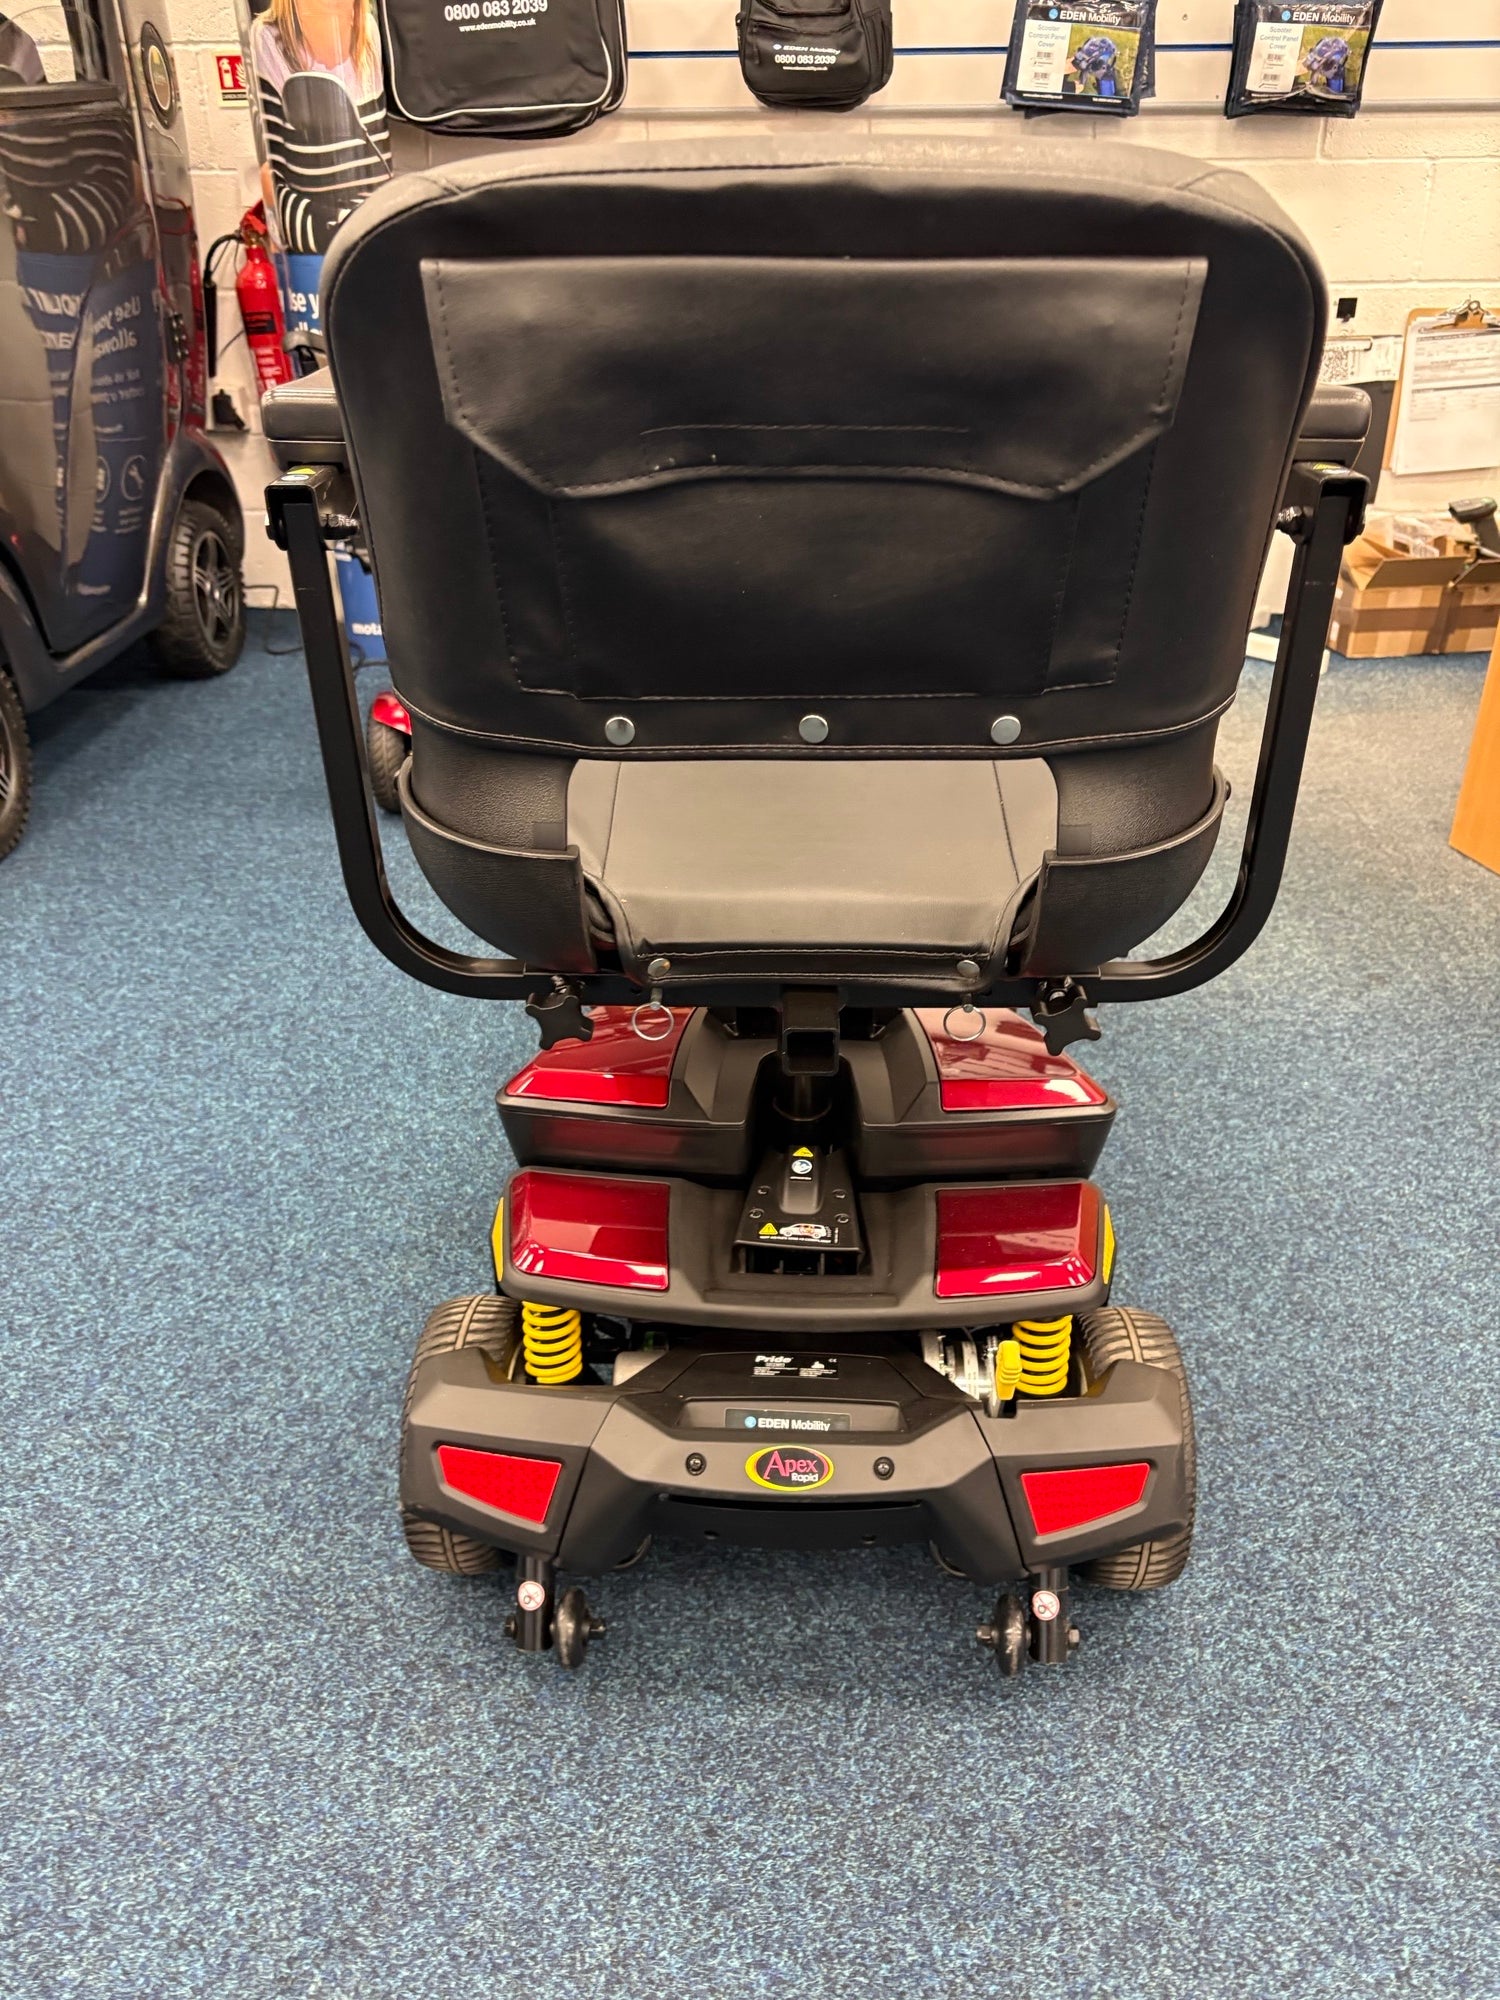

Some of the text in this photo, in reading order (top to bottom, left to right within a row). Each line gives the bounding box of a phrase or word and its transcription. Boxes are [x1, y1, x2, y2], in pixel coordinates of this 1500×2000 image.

[444, 0, 548, 21] 0800 083 2039
[1060, 10, 1121, 25] EDEN Mobility
[1293, 12, 1356, 25] EDEN Mobility
[458, 18, 537, 32] www.edenmobility.co.uk
[775, 55, 836, 64] 0800 083 2039
[755, 1355, 793, 1363] Pride
[758, 1418, 830, 1431] EDEN Mobility
[763, 1450, 818, 1480] Apex
[791, 1473, 819, 1483] Rapid
